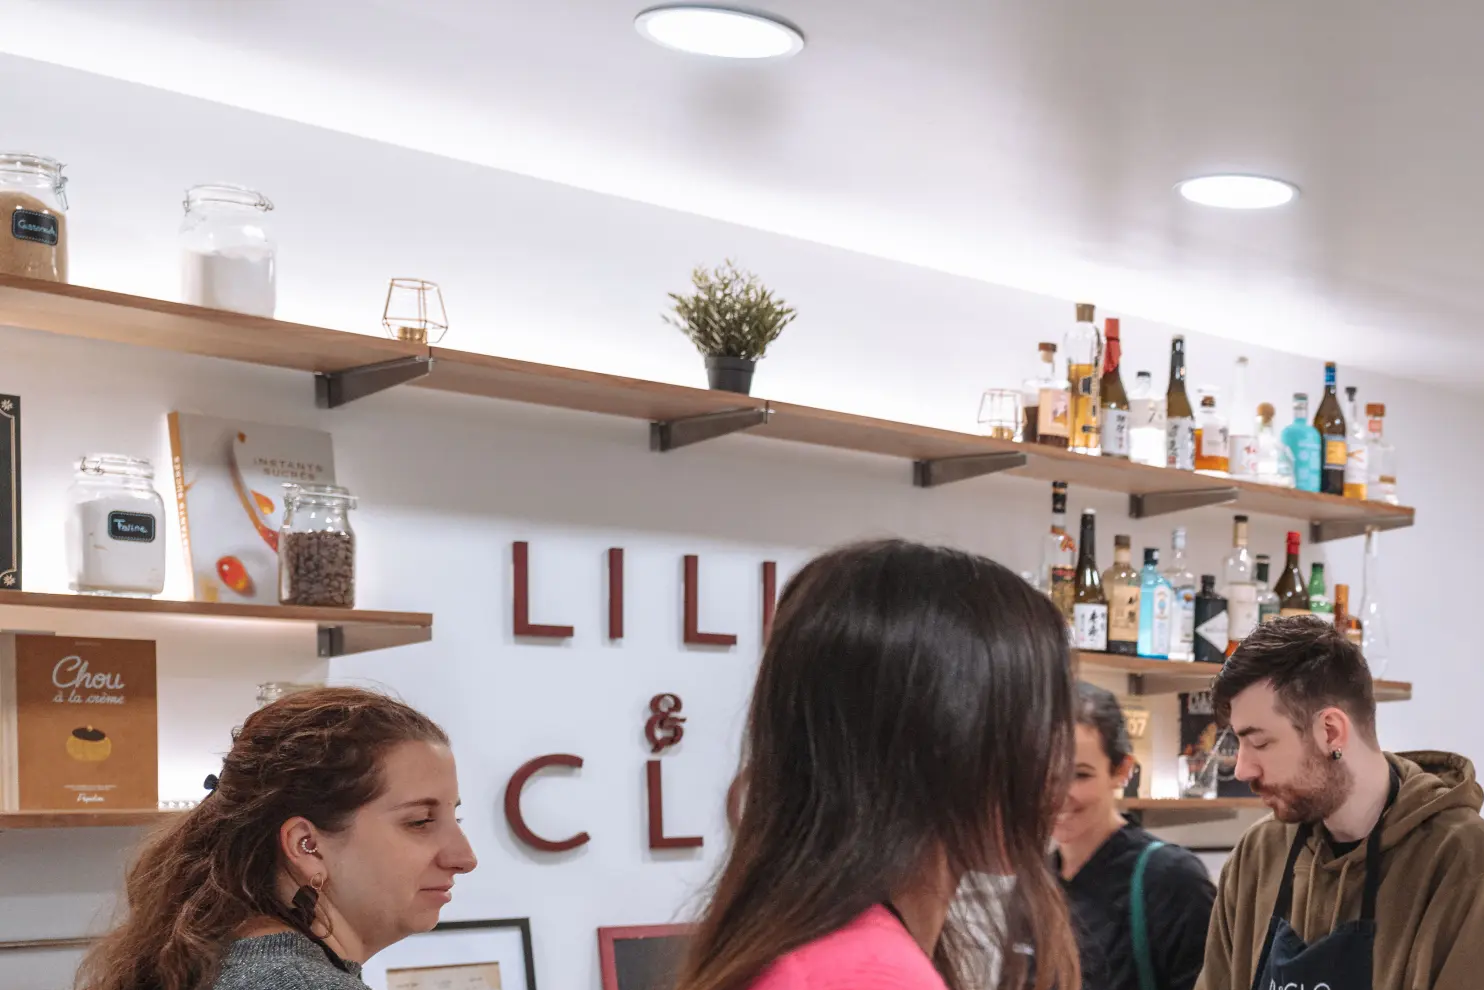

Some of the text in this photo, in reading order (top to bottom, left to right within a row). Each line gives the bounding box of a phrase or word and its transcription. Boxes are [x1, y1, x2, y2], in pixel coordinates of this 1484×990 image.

[513, 541, 777, 647] LILI
[52, 655, 126, 690] Chou
[504, 753, 746, 853] CL
